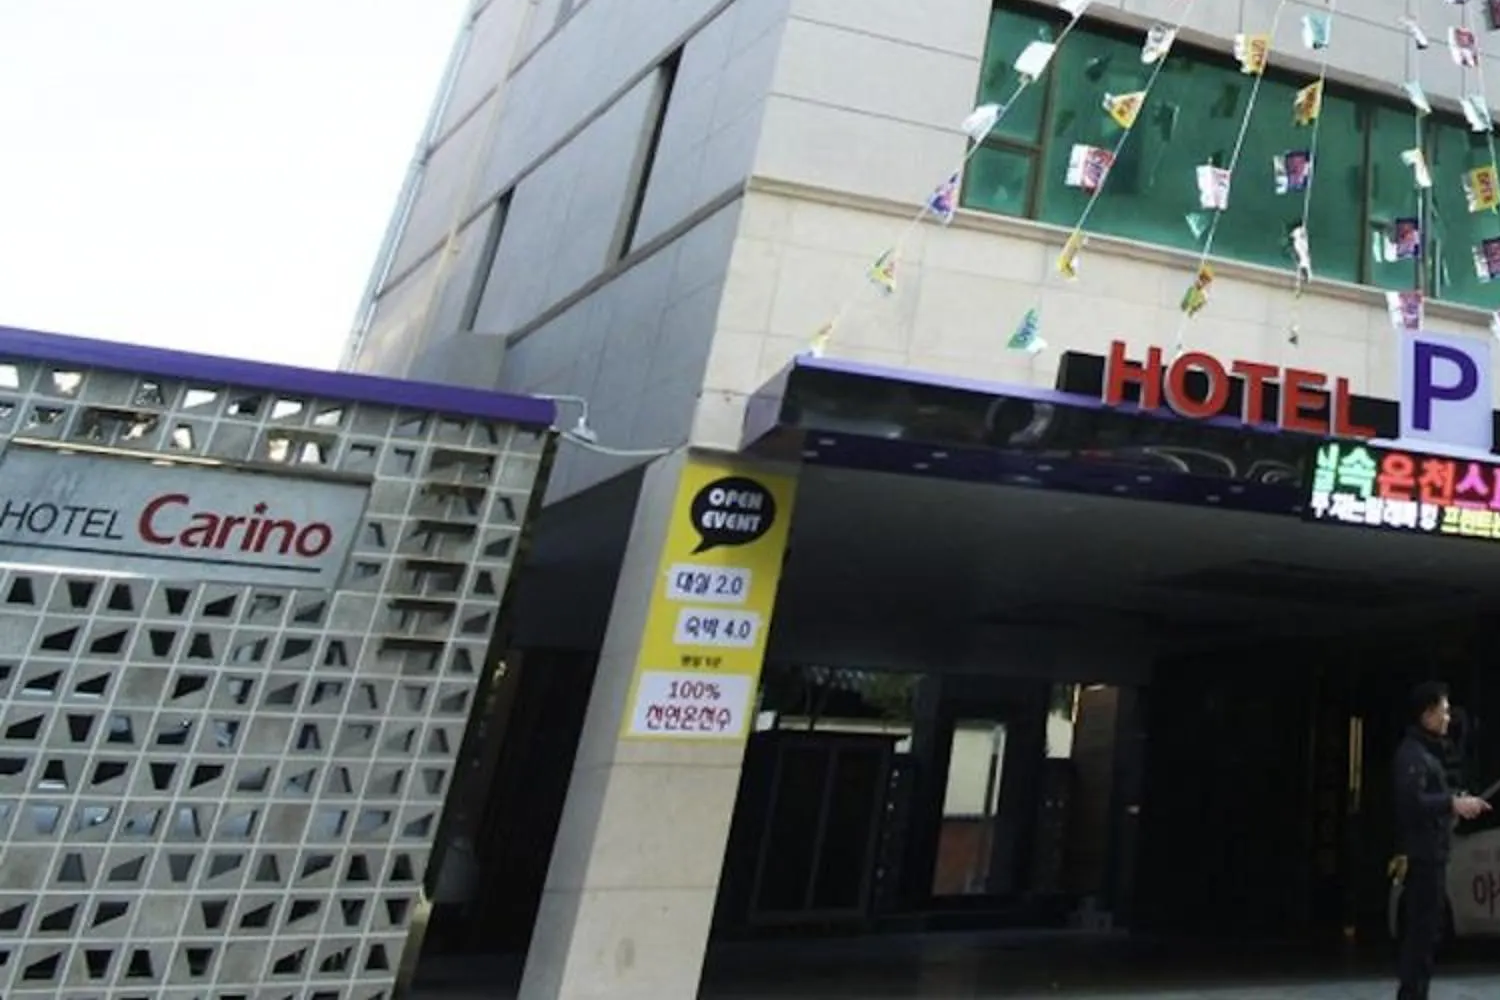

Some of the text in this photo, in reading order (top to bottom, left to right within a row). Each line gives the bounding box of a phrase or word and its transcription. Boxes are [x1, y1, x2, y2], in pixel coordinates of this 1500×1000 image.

[1103, 340, 1377, 438] HOTEL
[1411, 341, 1478, 431] P
[708, 487, 764, 510] OPEN
[0, 493, 333, 558] HOTEL Carino
[701, 510, 762, 533] EVENT
[715, 574, 744, 595] 2.0
[724, 619, 752, 640] 4.0
[668, 680, 721, 700] 100%
[645, 703, 732, 732] 천연온천수
